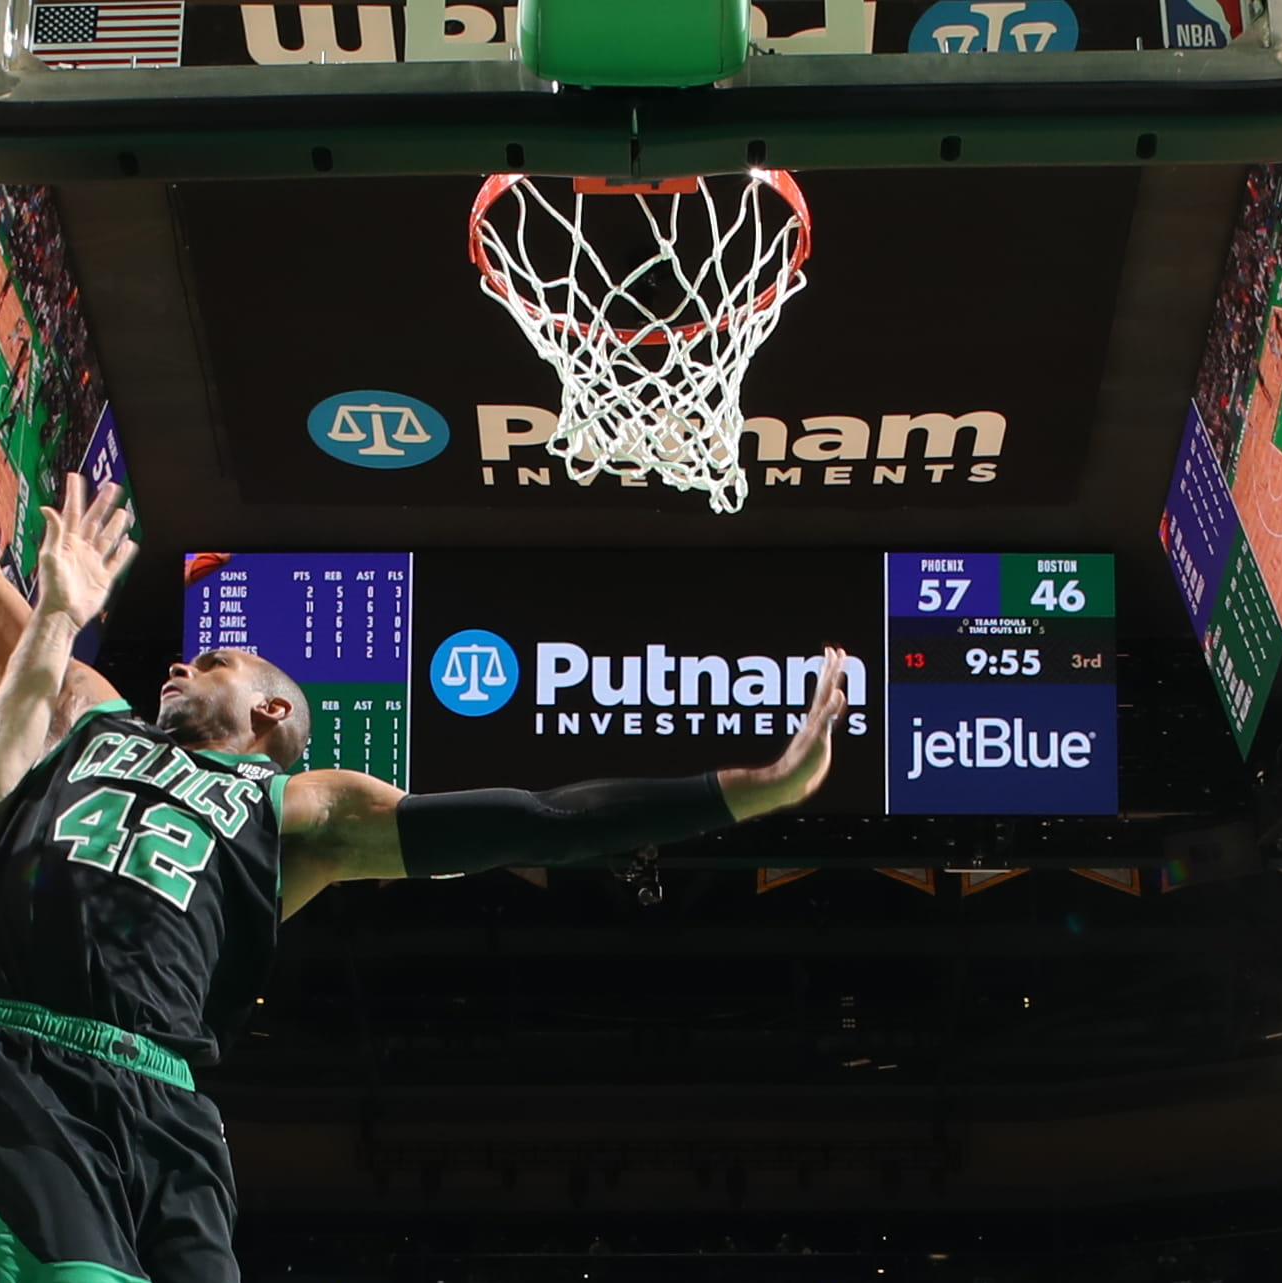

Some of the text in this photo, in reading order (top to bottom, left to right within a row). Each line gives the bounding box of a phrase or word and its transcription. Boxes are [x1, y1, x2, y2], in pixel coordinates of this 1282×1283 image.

[1176, 24, 1216, 47] NBA
[483, 463, 998, 486] INVEMENTS
[922, 560, 963, 572] PHOENIX
[1038, 560, 1077, 572] BOSTON
[221, 571, 403, 581] SUNS PTS REB AST FLS
[204, 586, 246, 598] 0 CRAIG
[918, 580, 971, 611] 57
[1031, 580, 1085, 612] 46
[203, 601, 242, 613] 3 PAUL
[200, 616, 246, 628] 20 SARIC
[199, 631, 247, 643] 22 AYTON
[905, 653, 924, 667] 13
[966, 649, 1040, 675] 9:55
[1072, 654, 1101, 668] 3rd
[536, 643, 866, 706] Putnam
[322, 701, 401, 710] REB AST FLS
[536, 713, 868, 735] INVESTMENS
[908, 718, 1091, 779] jetBlue
[67, 732, 263, 839] CELTICS
[53, 786, 217, 912] 42
